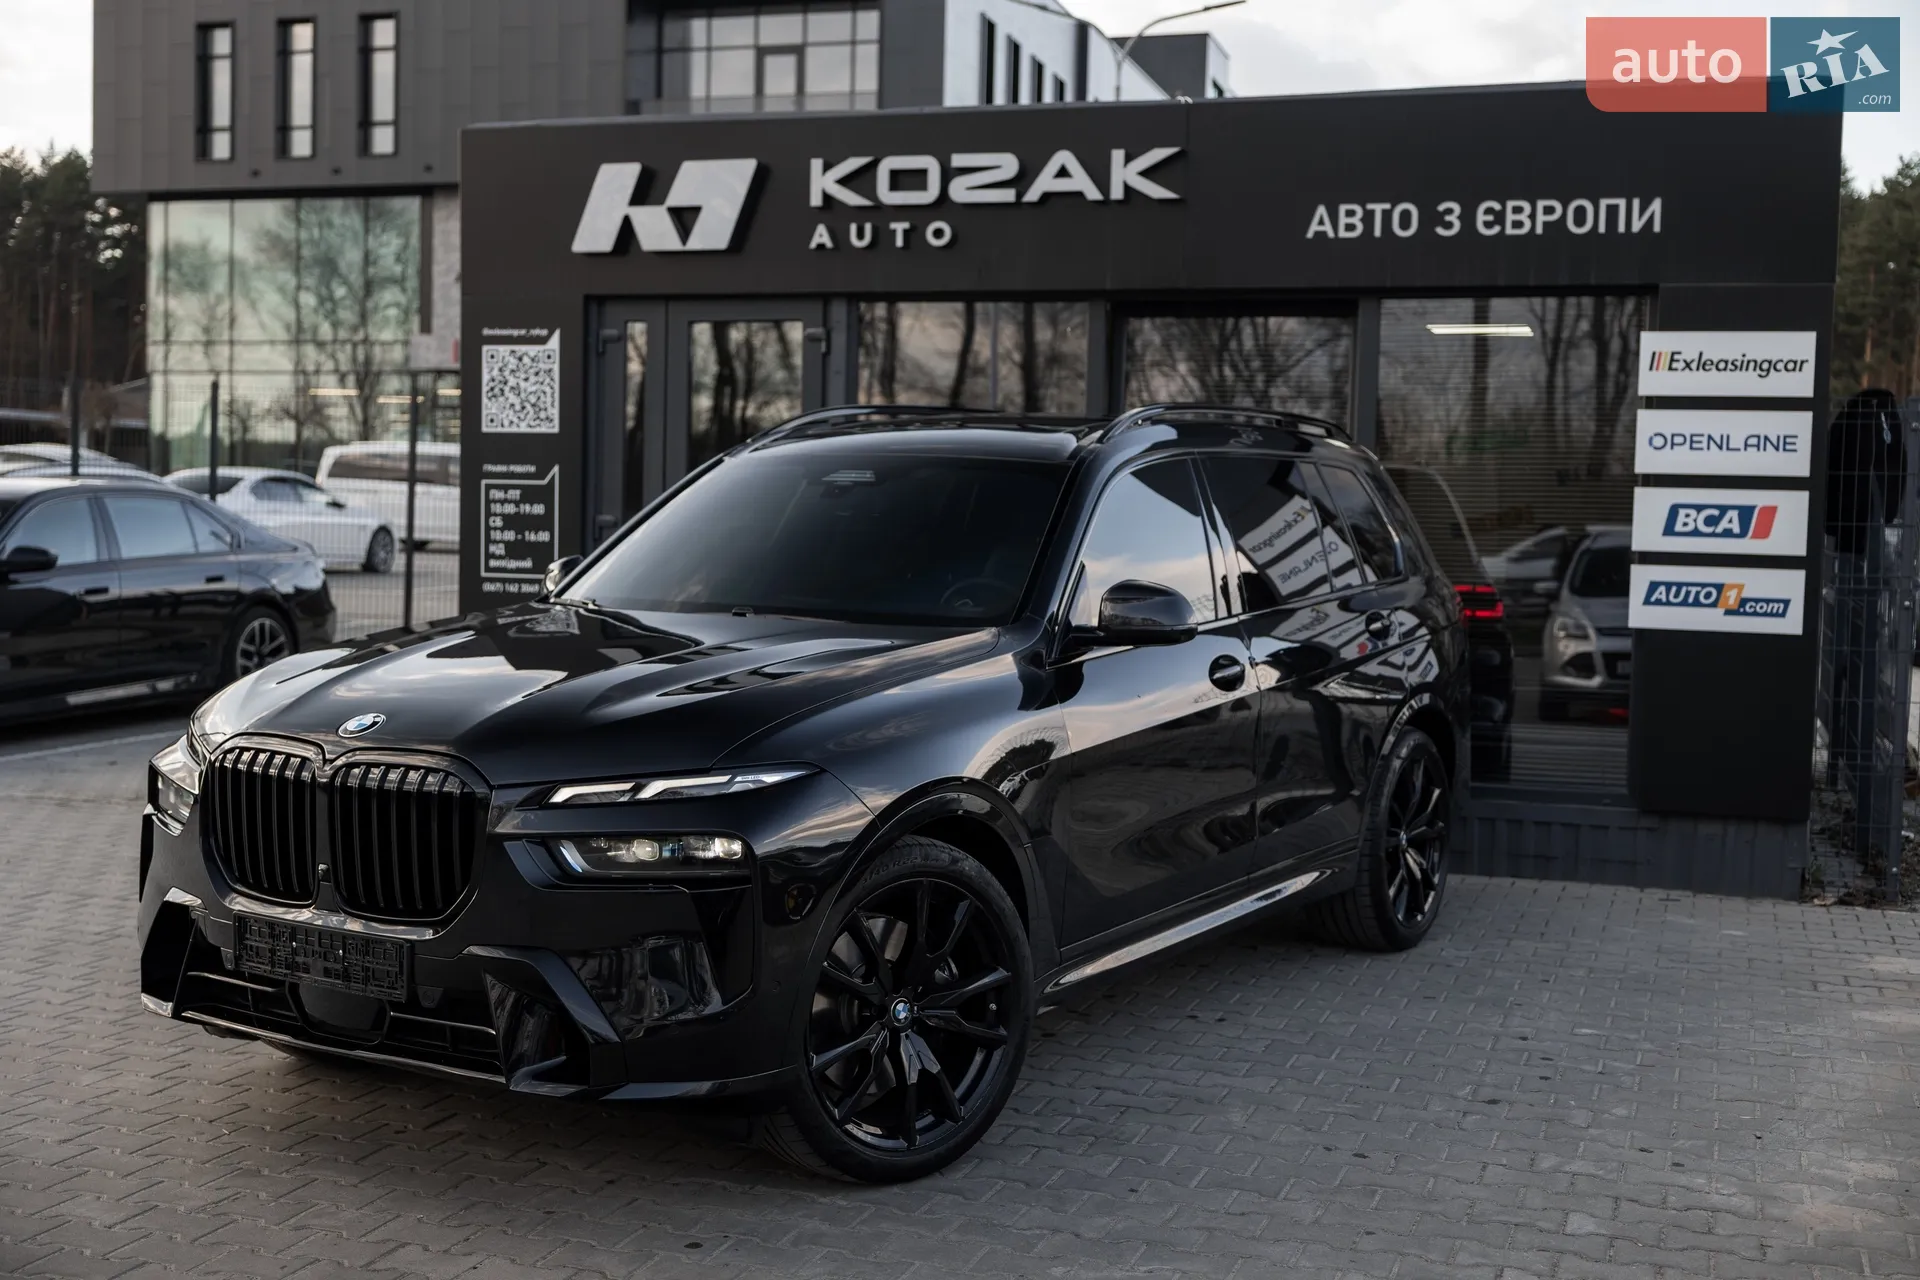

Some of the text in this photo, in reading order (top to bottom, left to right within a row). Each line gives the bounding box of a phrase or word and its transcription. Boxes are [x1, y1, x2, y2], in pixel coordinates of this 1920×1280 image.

[809, 147, 1182, 207] KOZAK
[1307, 202, 1419, 239] АВТО
[1475, 197, 1663, 235] ЄВРОПИ
[808, 220, 953, 250] AUTO
[1667, 351, 1810, 378] Exleasingcar
[1648, 432, 1799, 453] OPENLANE
[1673, 507, 1742, 534] BCA
